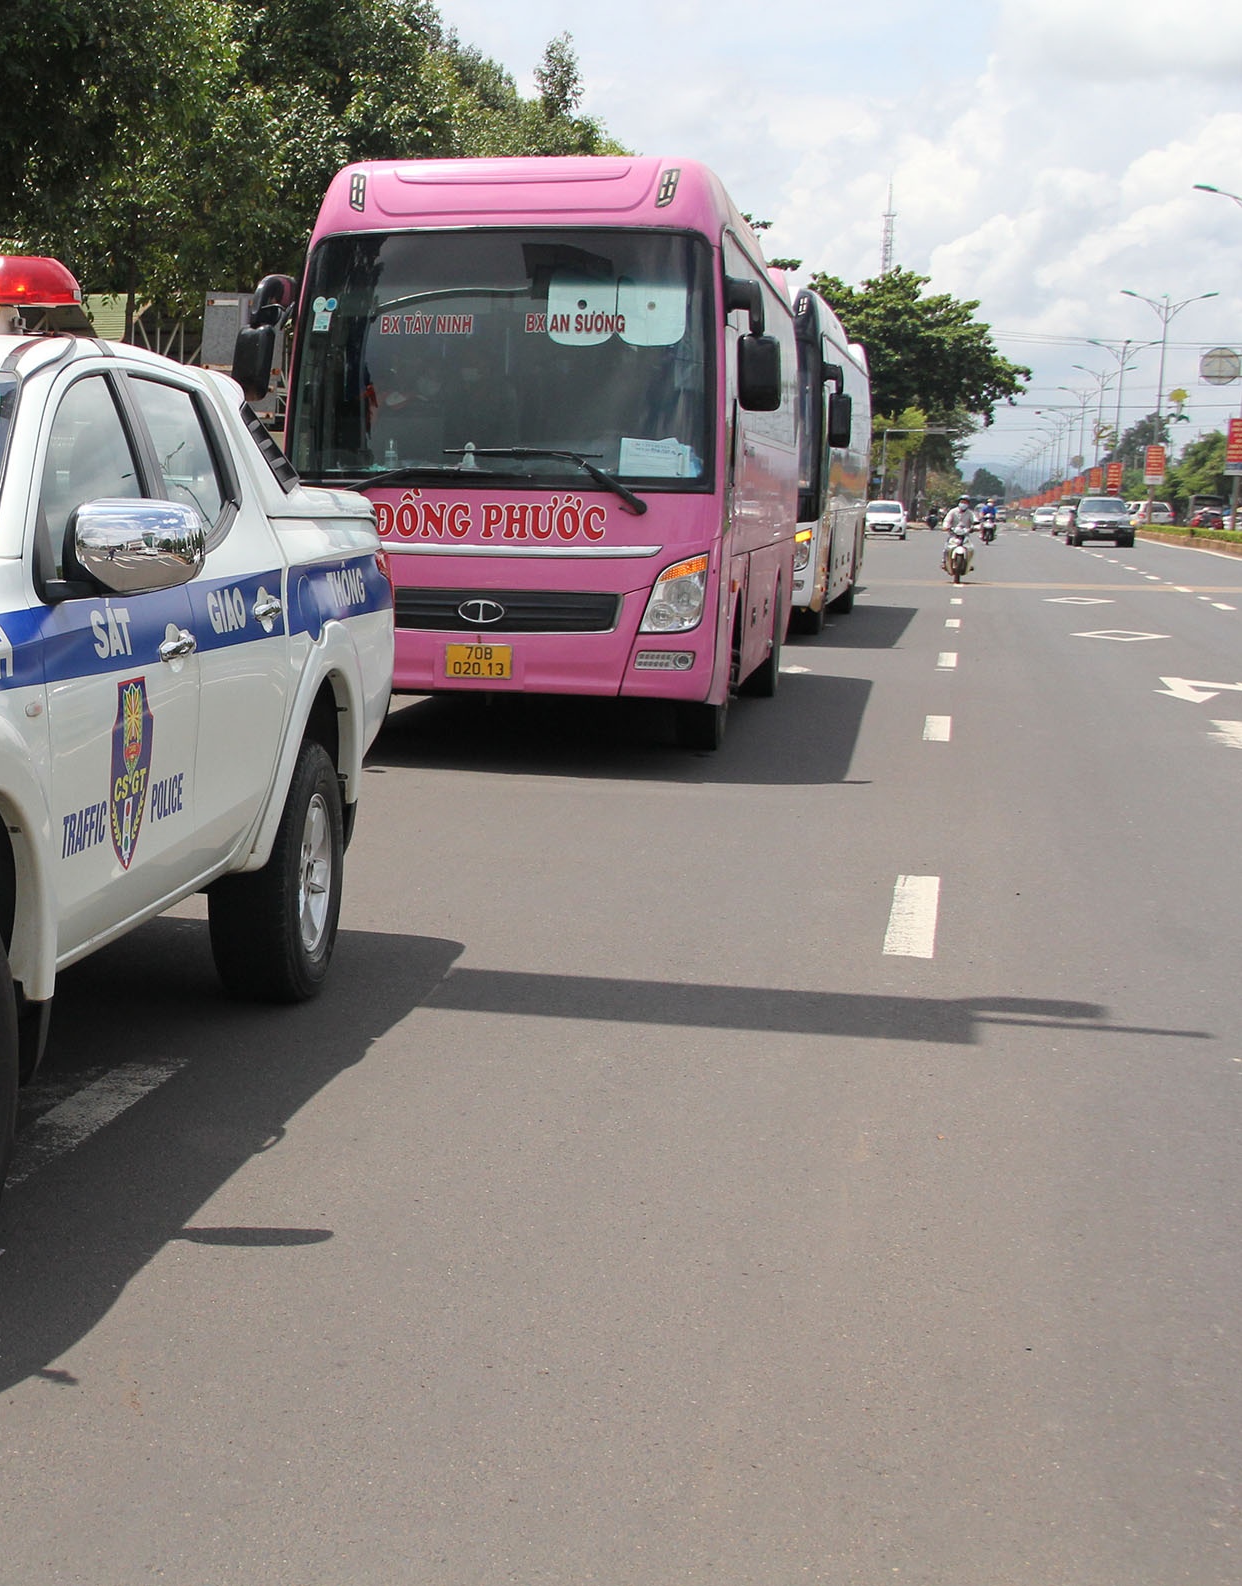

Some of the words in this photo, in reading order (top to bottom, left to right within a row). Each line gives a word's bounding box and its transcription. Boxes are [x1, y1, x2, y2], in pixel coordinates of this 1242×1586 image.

[380, 315, 401, 334] BX
[404, 310, 434, 334] TÂY
[436, 314, 473, 334] NINH
[525, 313, 546, 333] BX
[550, 314, 570, 332] AN
[575, 310, 625, 332] SƯƠNG
[372, 488, 472, 538] ĐỒNG
[480, 494, 607, 542] PHƯỚC
[89, 598, 132, 660] SÁT
[206, 586, 246, 634] GIAO
[326, 562, 366, 608] THÔNG
[465, 646, 493, 660] 70B
[453, 661, 504, 676] 020.13
[62, 800, 107, 859] TRAFFIC
[150, 772, 184, 823] POLICE
